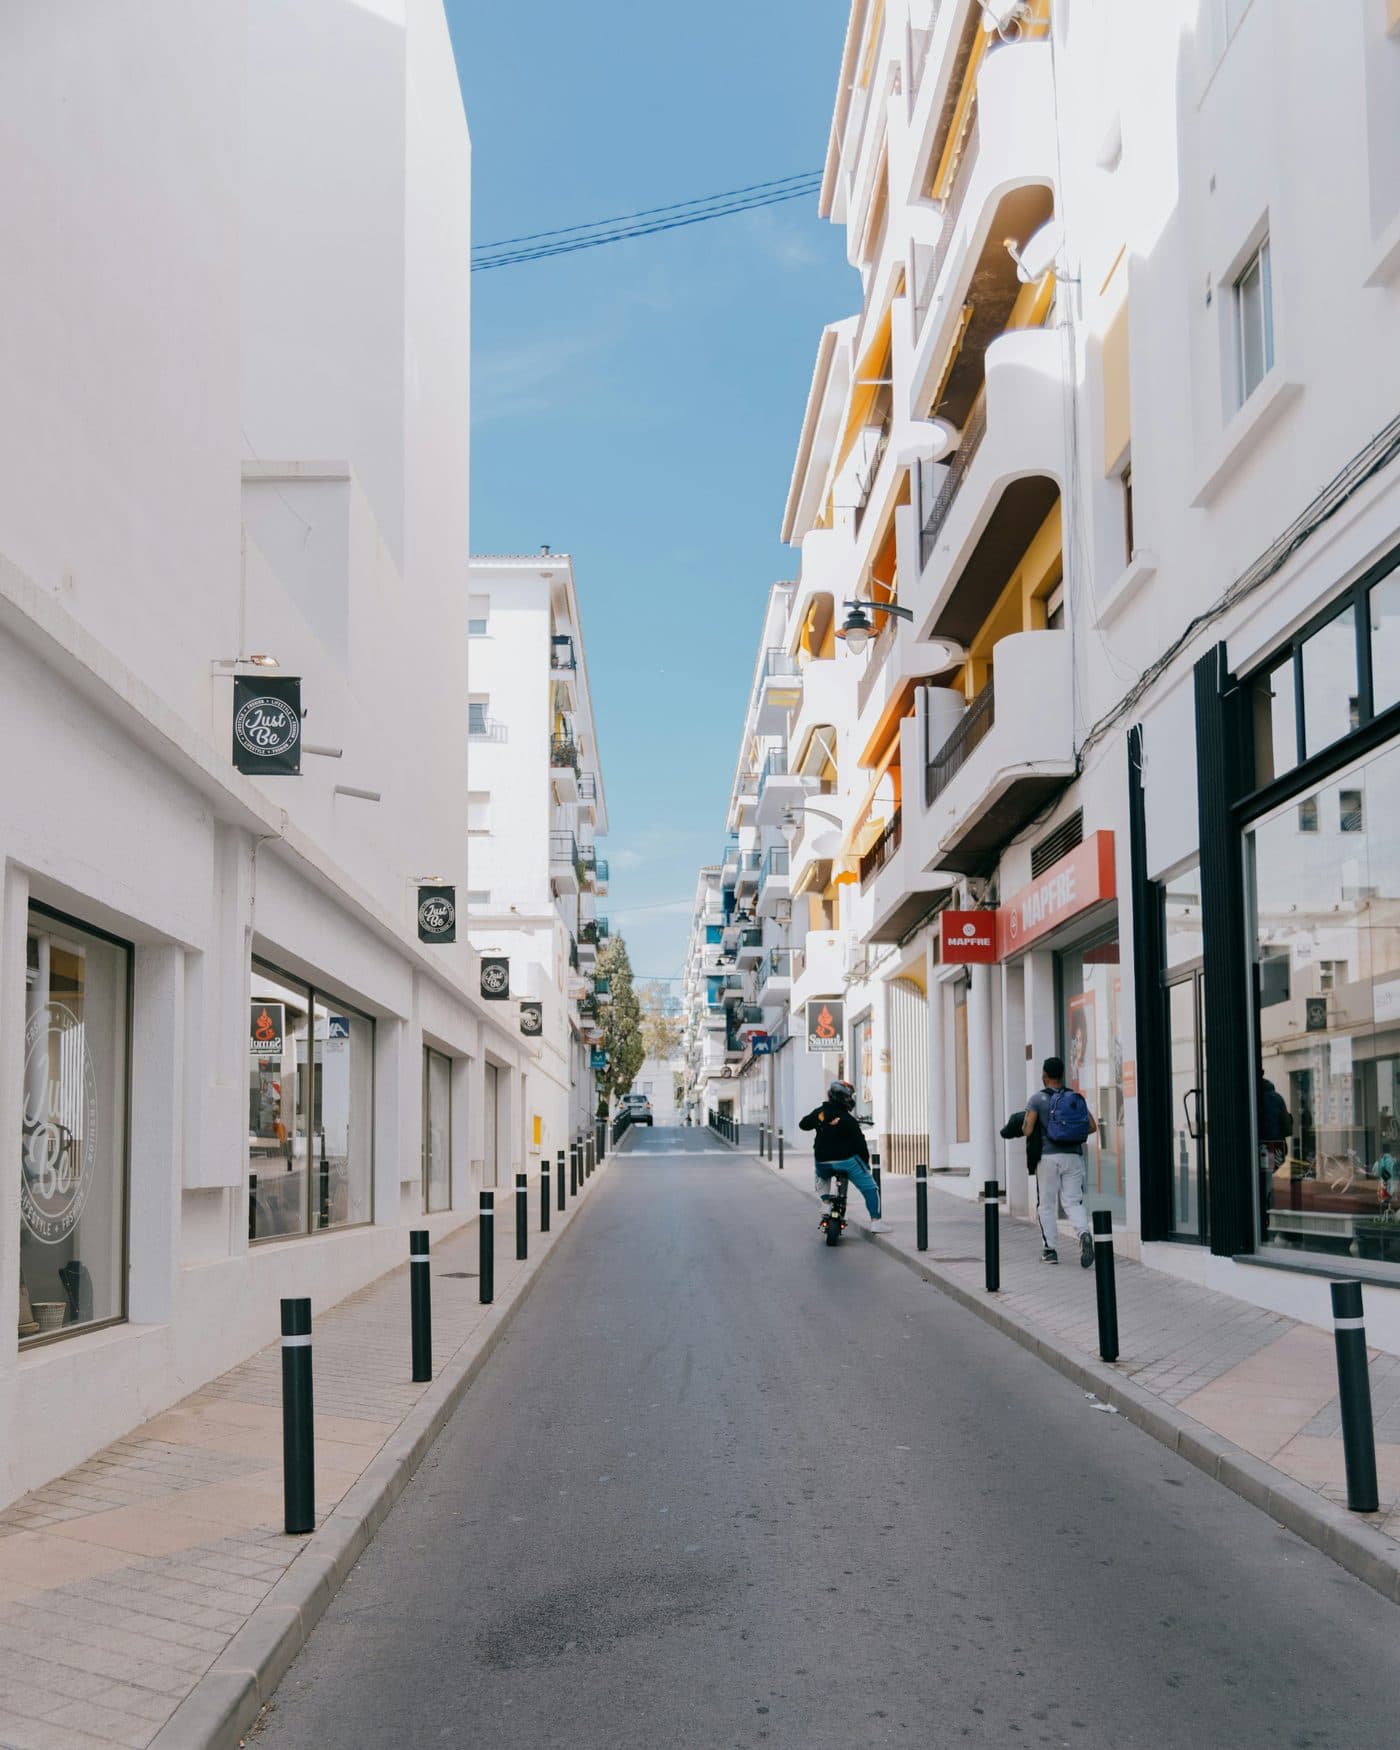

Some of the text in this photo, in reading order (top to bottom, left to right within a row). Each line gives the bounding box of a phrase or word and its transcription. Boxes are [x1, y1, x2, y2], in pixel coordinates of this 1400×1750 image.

[245, 710, 286, 728] Just
[250, 726, 280, 745] Be
[1022, 864, 1076, 931] MAPFRE
[424, 905, 448, 917] Just
[426, 915, 445, 927] Be
[948, 938, 991, 946] MAPFRE
[29, 1122, 71, 1199] Be
